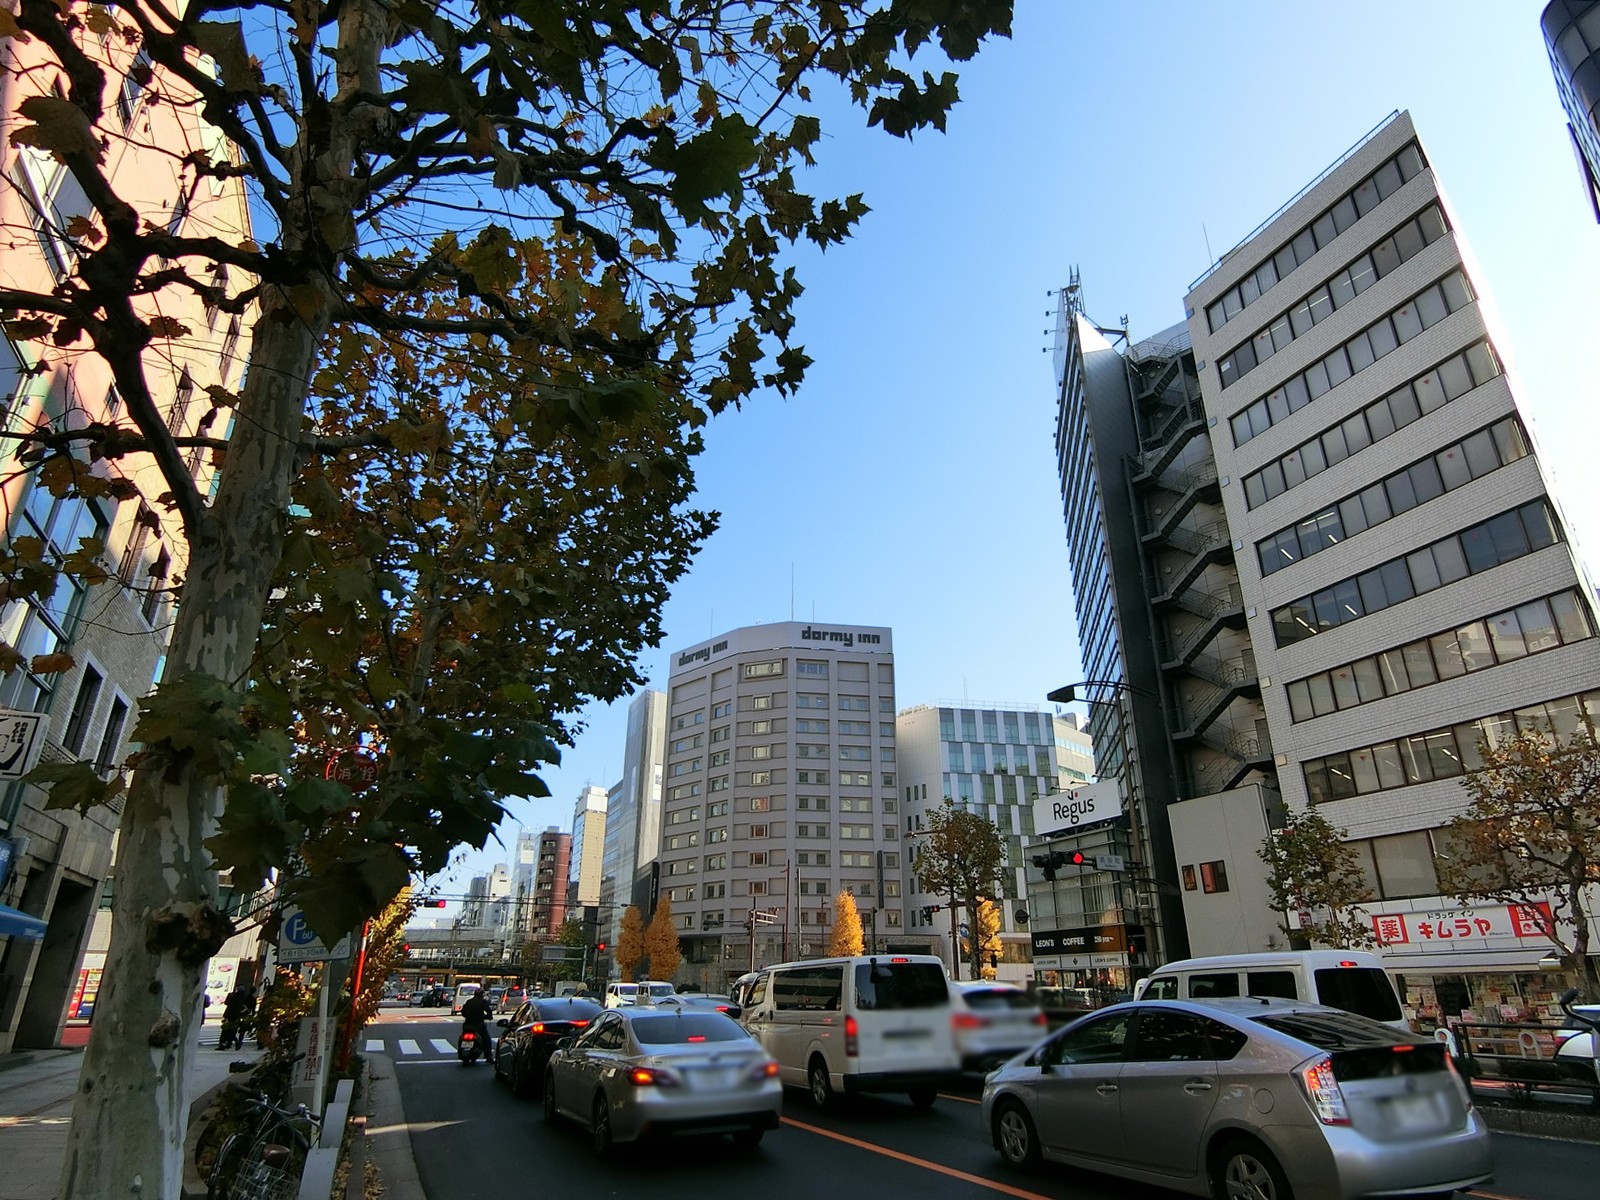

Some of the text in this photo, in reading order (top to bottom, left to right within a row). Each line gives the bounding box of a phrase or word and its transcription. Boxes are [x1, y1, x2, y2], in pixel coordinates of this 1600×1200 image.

[802, 626, 880, 647] dormy inn
[678, 640, 728, 667] dormy inn
[337, 765, 375, 782] 消栓
[1052, 798, 1095, 825] Regus
[1427, 910, 1475, 920] ドラッグ・イン
[292, 918, 307, 940] P
[1380, 919, 1400, 939] 薬
[1418, 918, 1491, 939] キムラヤ
[1035, 938, 1055, 948] LEON'S
[1062, 937, 1085, 946] COFFEE
